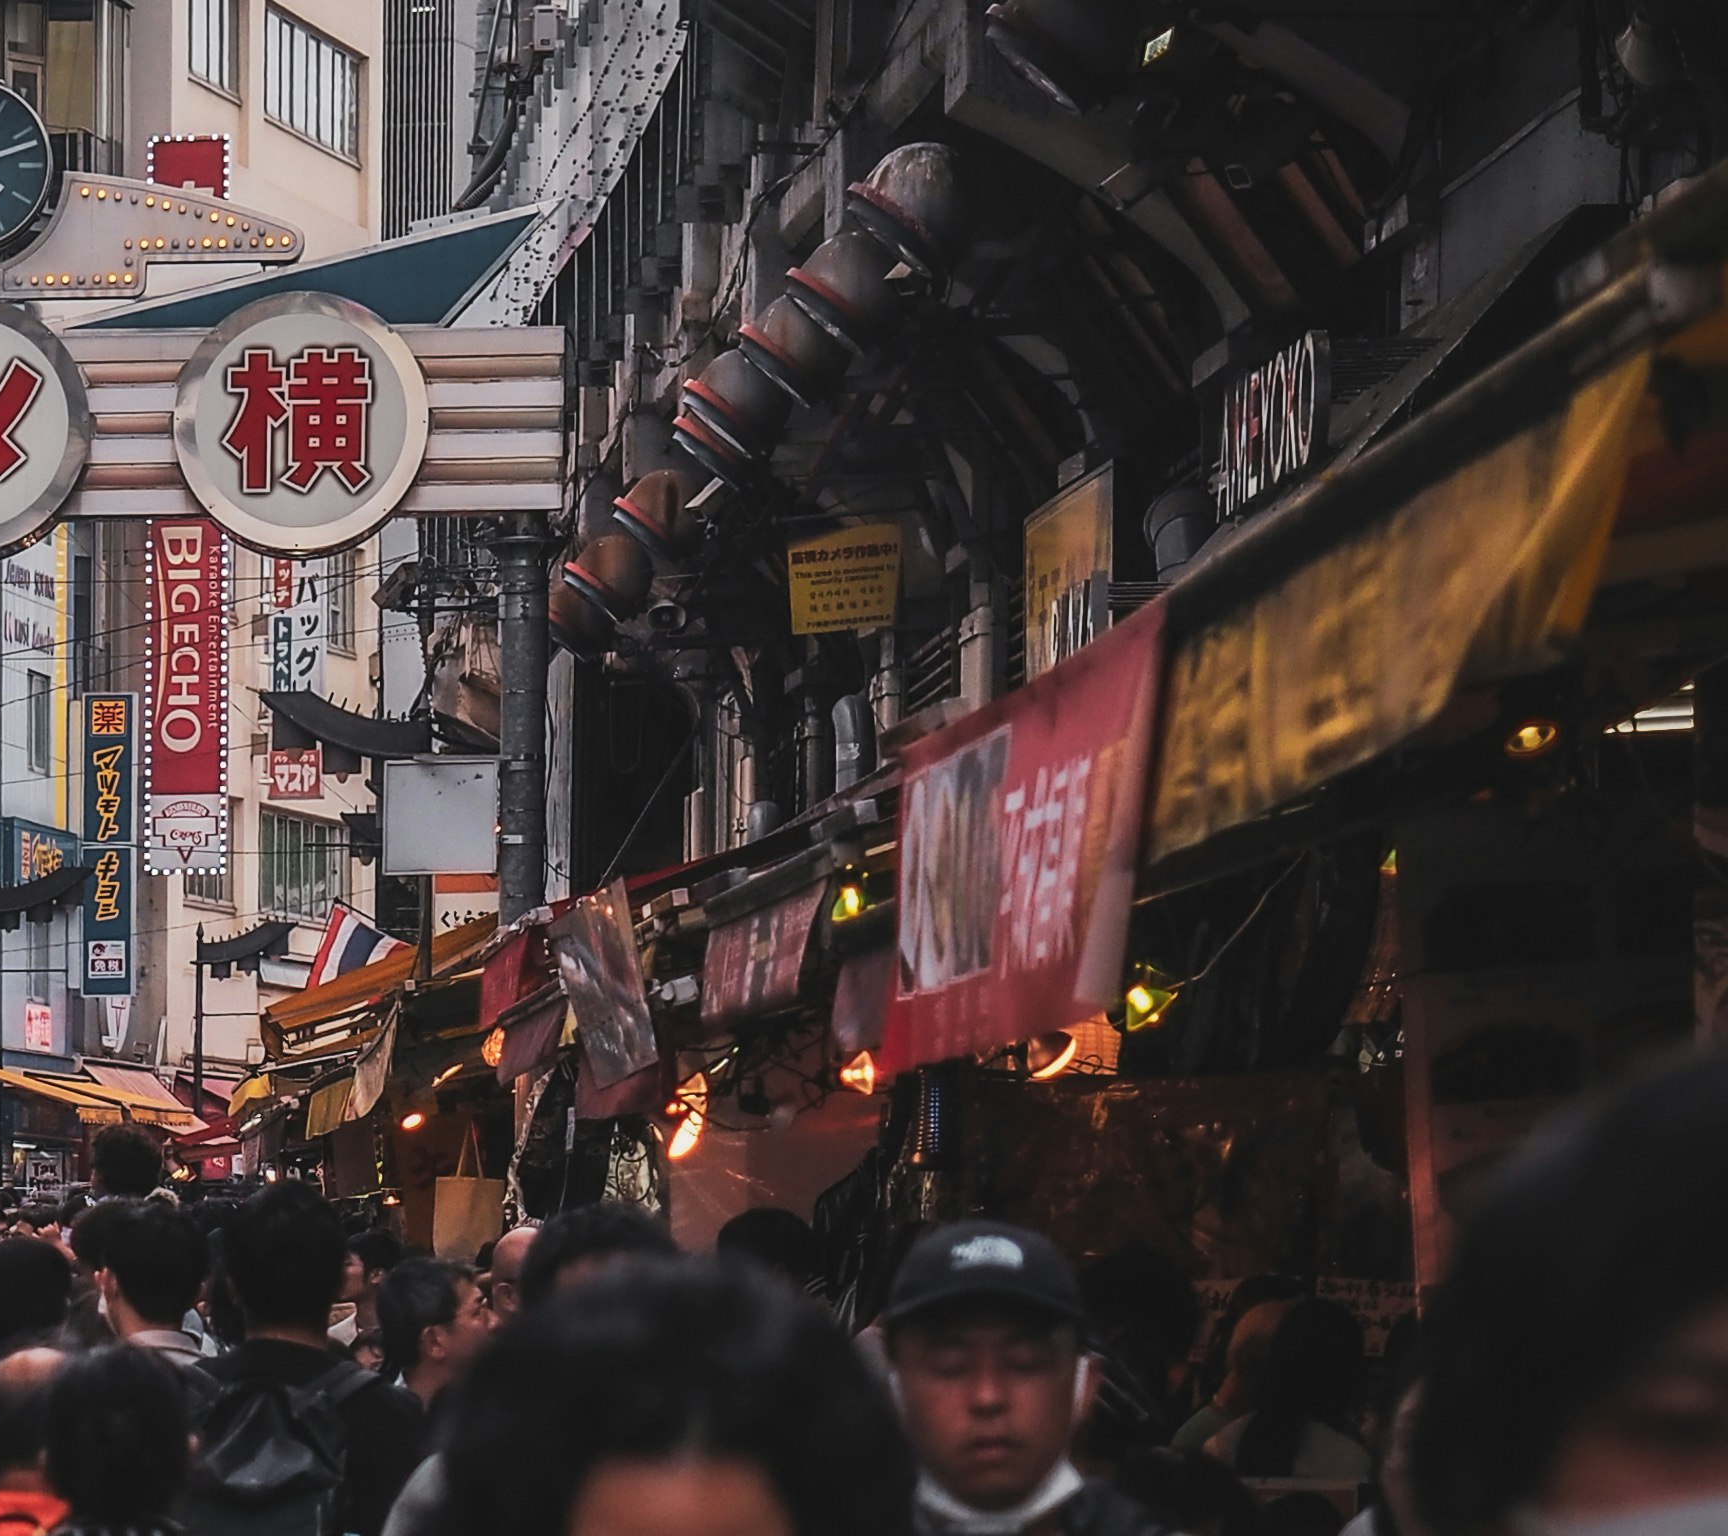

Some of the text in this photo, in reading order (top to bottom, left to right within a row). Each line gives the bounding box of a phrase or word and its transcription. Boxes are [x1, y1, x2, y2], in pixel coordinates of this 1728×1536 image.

[1216, 330, 1315, 524] AMEYOKO
[160, 525, 203, 613] BIG
[276, 558, 291, 604] ッチ
[207, 545, 221, 729] Karaoke Entertainment
[275, 621, 290, 692] トラベル
[93, 702, 124, 732] 薬
[160, 623, 203, 753] ECHO
[274, 763, 317, 792] マスヤ
[32, 1162, 57, 1177] Tax
